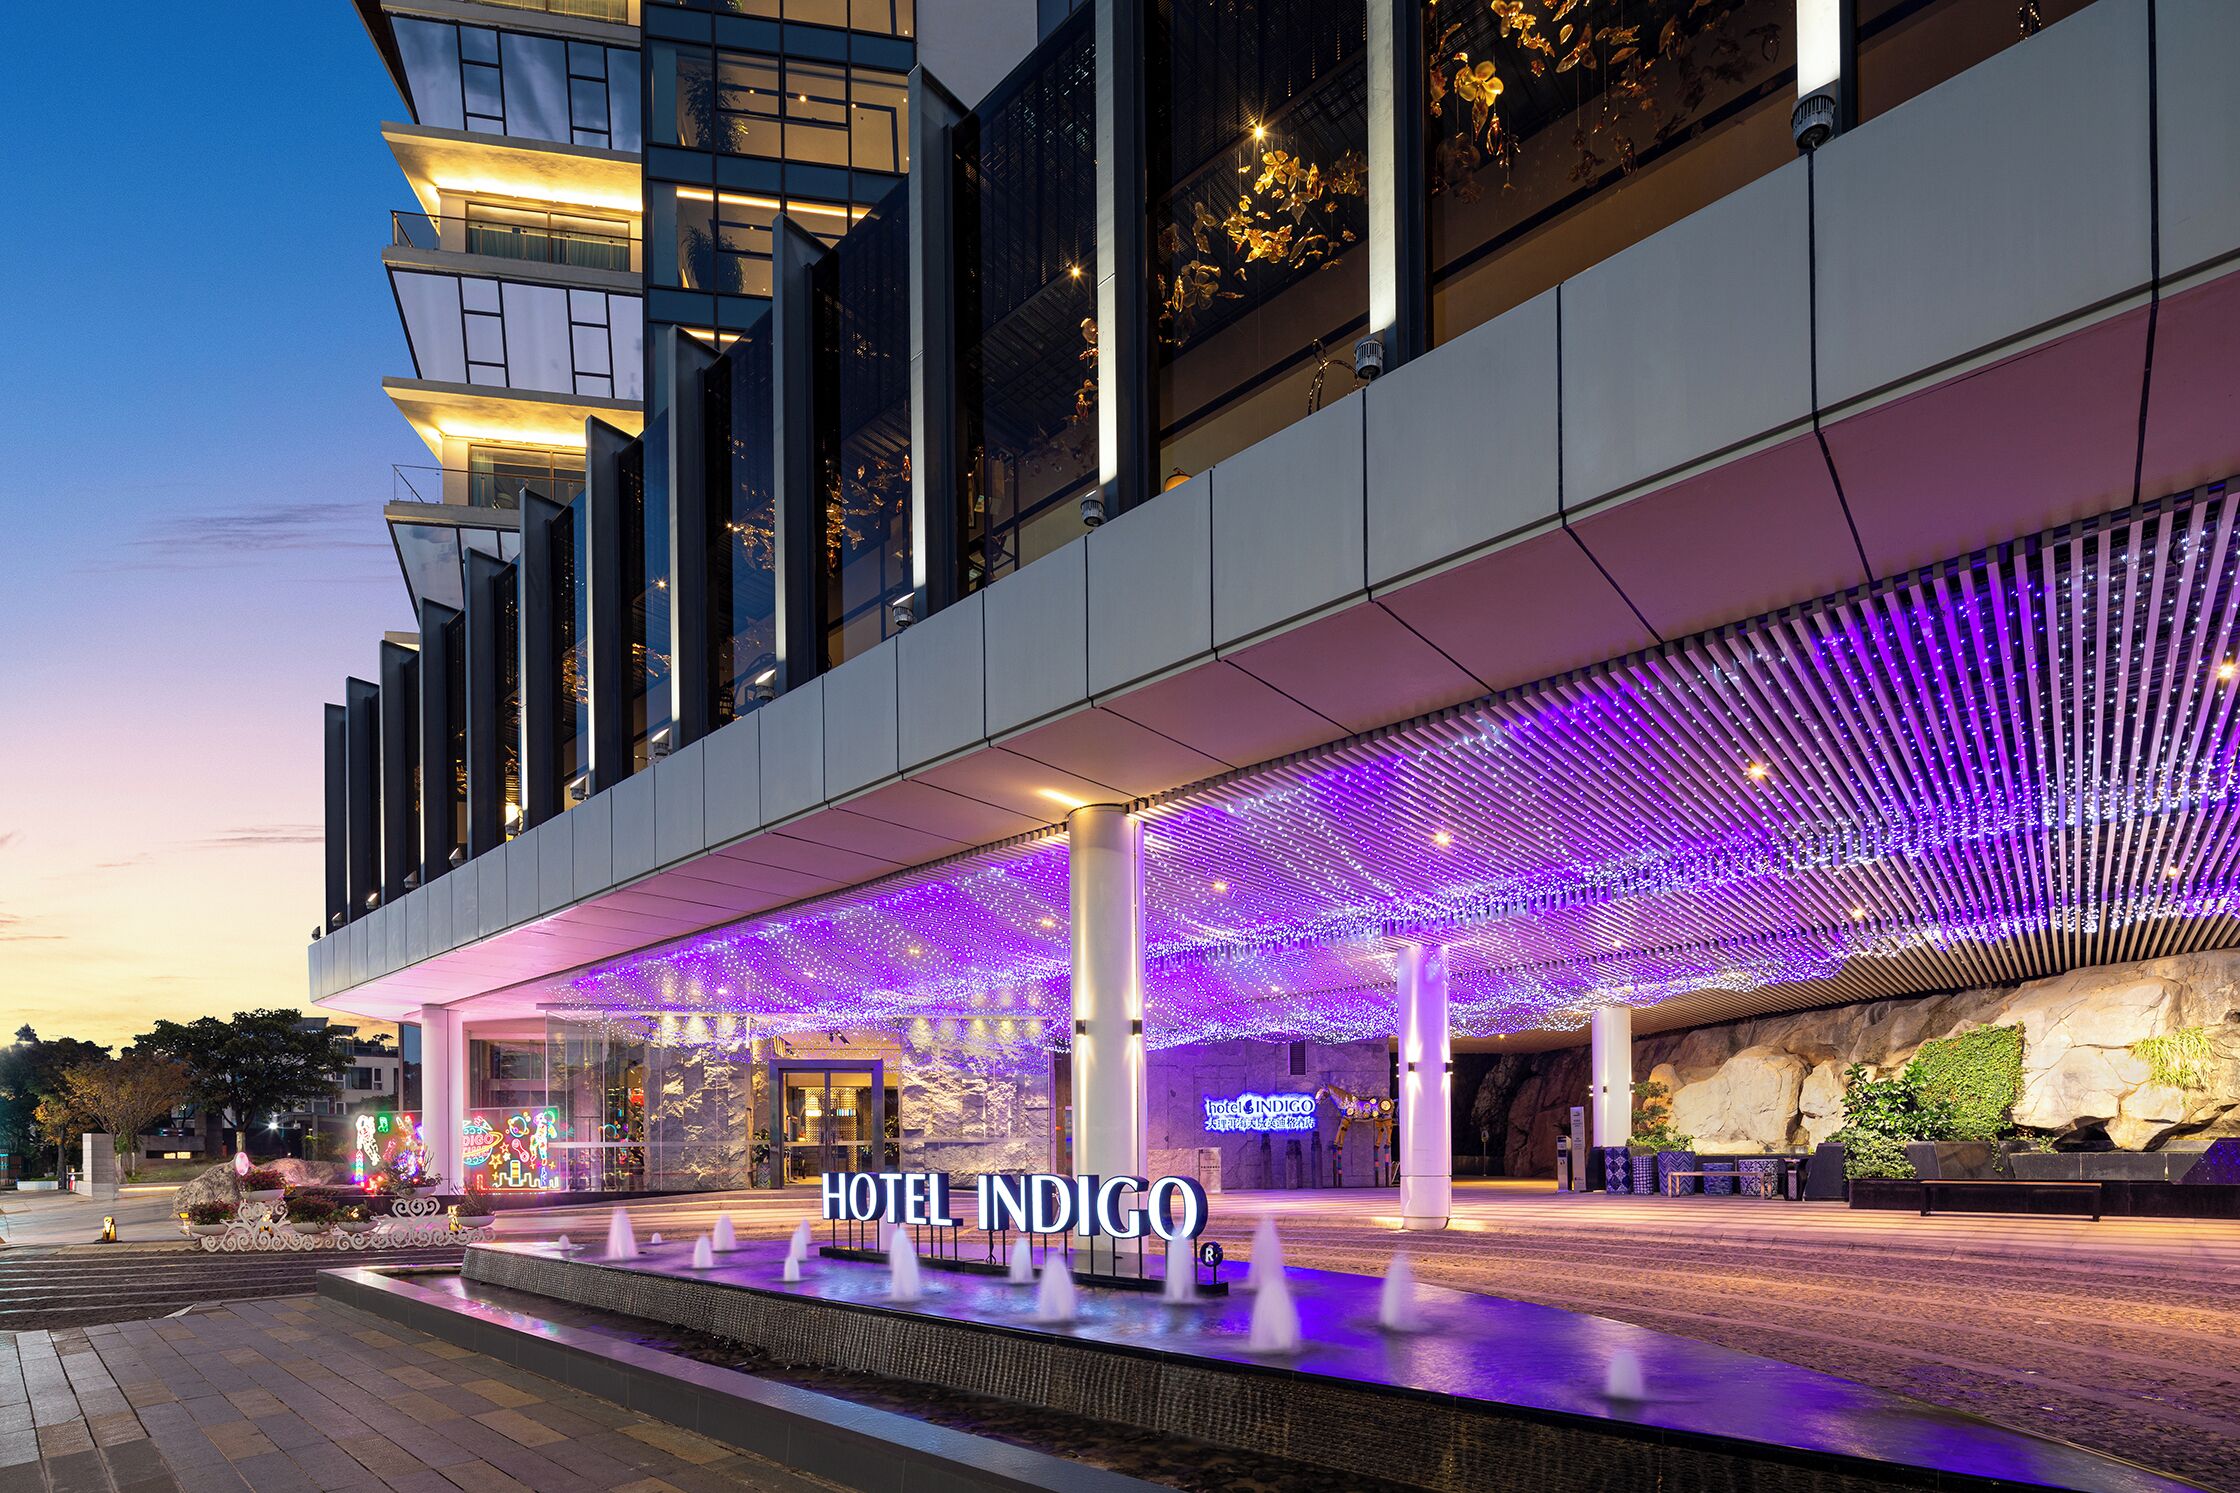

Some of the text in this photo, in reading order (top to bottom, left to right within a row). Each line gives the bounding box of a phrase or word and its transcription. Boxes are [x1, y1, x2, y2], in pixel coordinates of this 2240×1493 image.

[1208, 1100, 1314, 1114] hotel INDIGO
[463, 1134, 494, 1146] DIGO
[821, 1172, 958, 1227] HOTEL
[977, 1174, 1204, 1241] INDIGO
